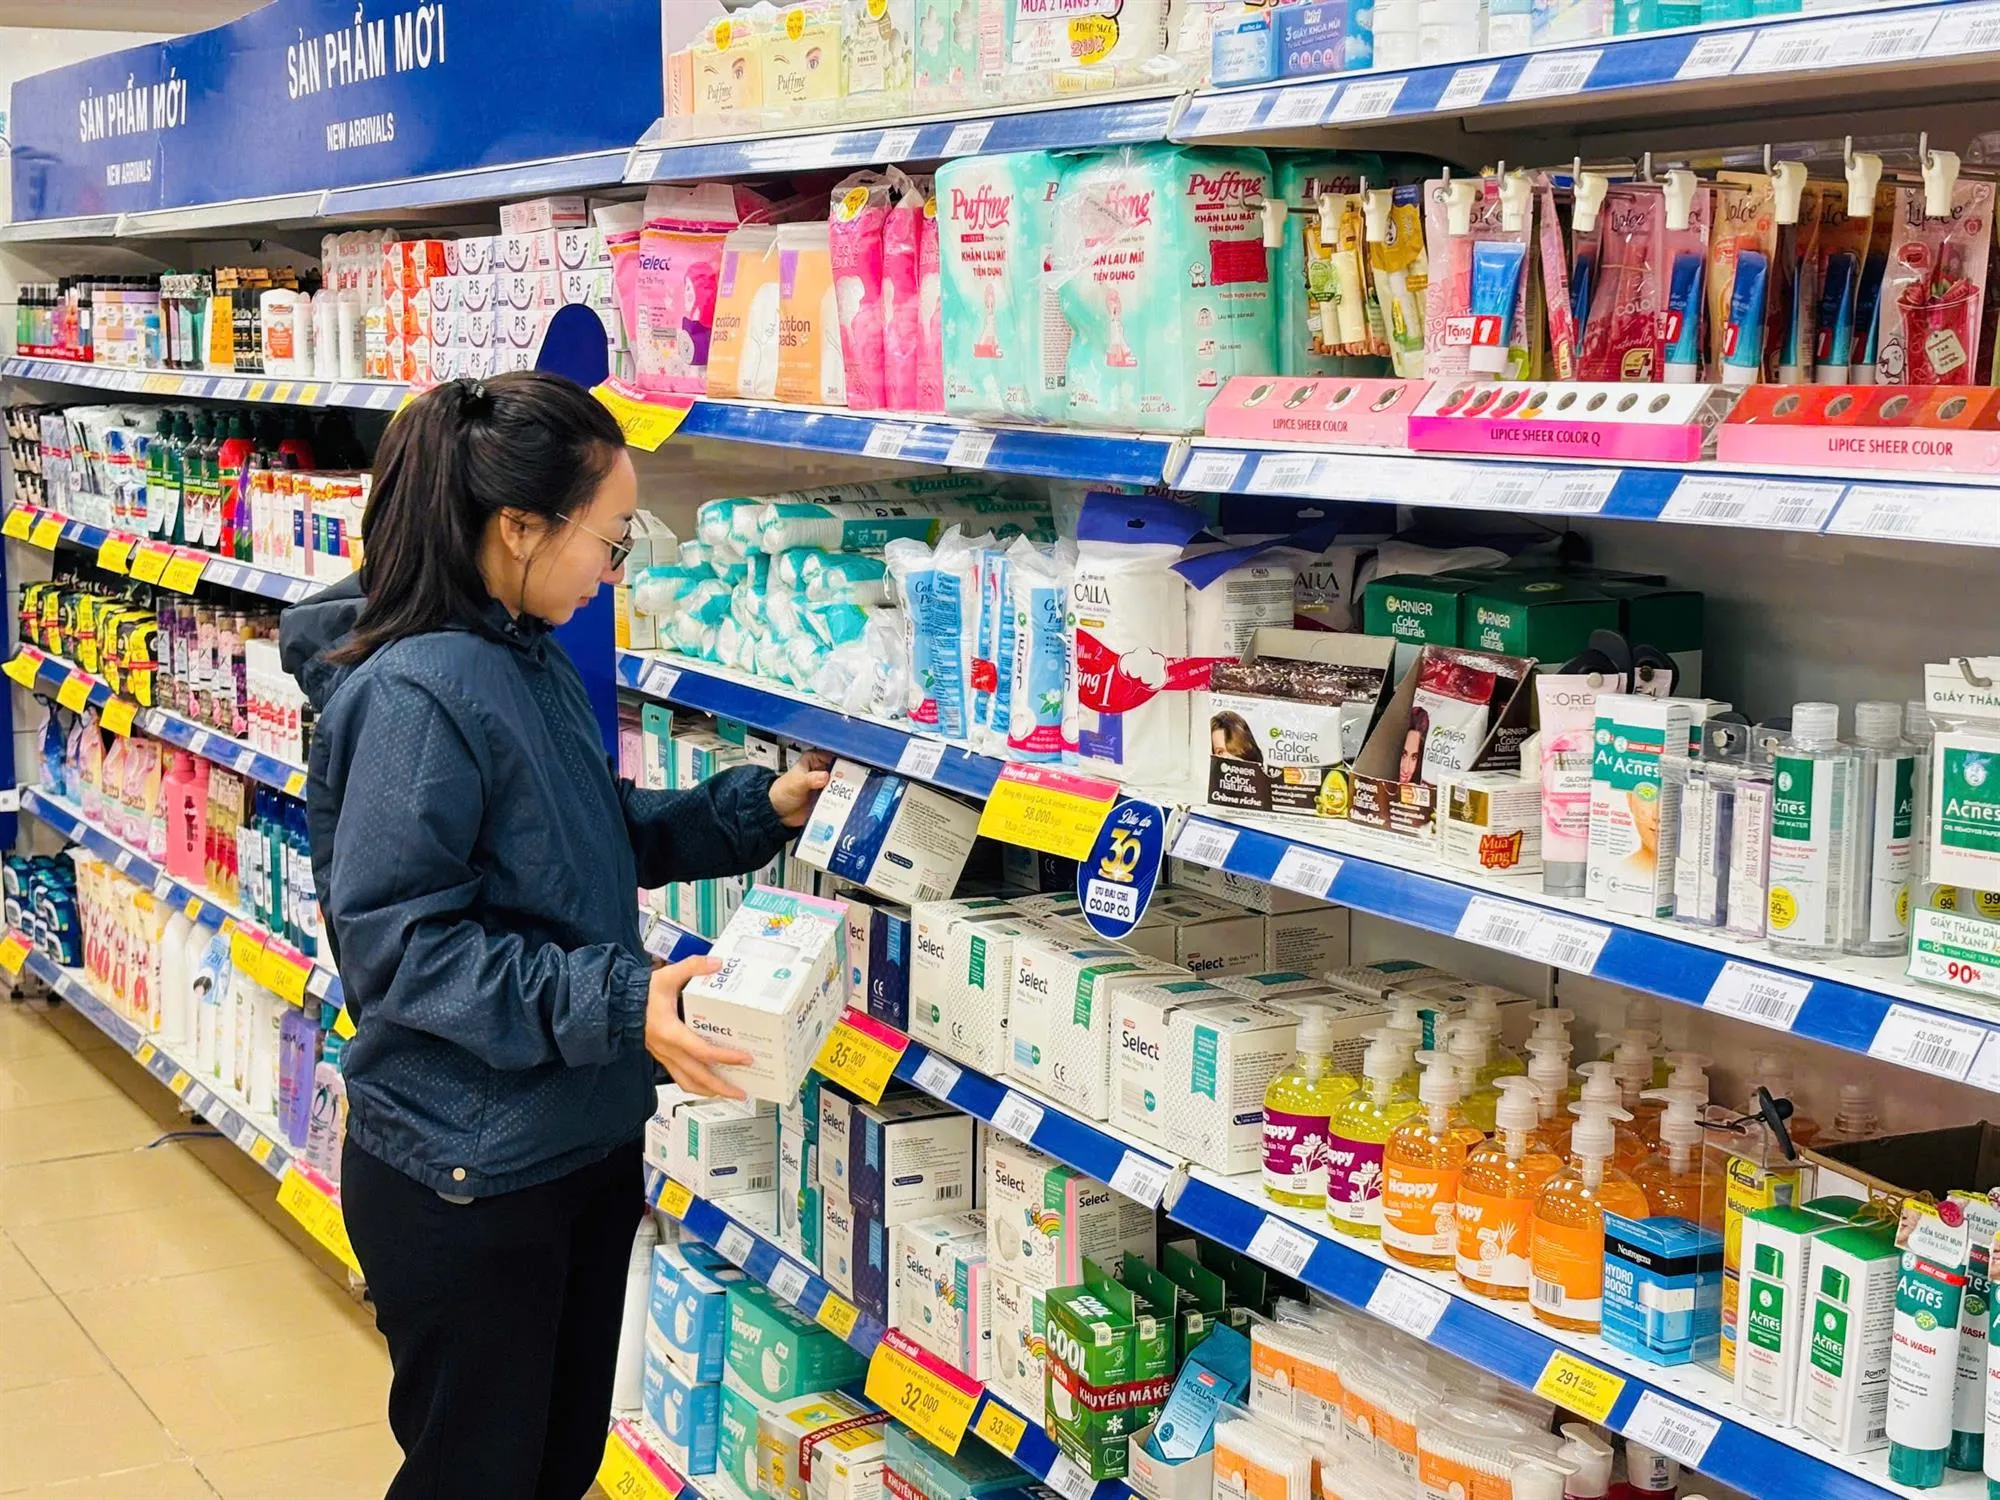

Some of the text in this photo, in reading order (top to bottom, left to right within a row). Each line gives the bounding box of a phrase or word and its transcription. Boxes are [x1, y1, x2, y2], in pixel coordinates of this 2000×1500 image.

[287, 2, 386, 100] SẢN PHẨM
[79, 66, 187, 143] SẢN PHẨM MỚI
[326, 112, 394, 151] NEW ARRIVALS
[106, 160, 152, 186] NEW ARRIVALS
[1186, 171, 1264, 201] Puffme
[951, 185, 1011, 230] Puffme
[1221, 214, 1238, 222] LAU
[509, 239, 520, 256] PS
[565, 235, 578, 251] PS
[513, 278, 525, 294] PS
[569, 276, 581, 293] PS
[514, 315, 527, 332] PS
[1447, 320, 1493, 343] Tặng 1
[1273, 419, 1348, 432] LIPICE SHEER COLOR
[1490, 429, 1600, 445] LIPICE SHEER COLOR Q
[1828, 438, 1953, 456] LIPICE SHEER COLOR
[1074, 583, 1110, 606] CALLA
[1386, 595, 1433, 616] GARNIER
[1397, 615, 1419, 628] Color
[1477, 607, 1510, 628] GARNIER
[1392, 623, 1425, 638] naturals
[1484, 627, 1501, 641] Color
[1100, 665, 1115, 707] 1
[1270, 728, 1318, 741] GARNIER
[1269, 748, 1320, 764] naturals
[1275, 741, 1310, 753] Color
[1425, 748, 1461, 770] naturals
[1613, 757, 1661, 778] Acnes
[1220, 763, 1255, 776] GARNIER
[1224, 773, 1250, 785] Color
[828, 780, 854, 799] Select
[1220, 779, 1256, 794] naturals
[1481, 836, 1507, 849] Mua
[1510, 832, 1522, 862] 1
[1481, 850, 1511, 868] Tặng
[1930, 916, 1951, 932] GIẤY
[1954, 920, 1981, 935] THẤM
[917, 934, 945, 959] Select
[1961, 936, 1988, 949] XANH
[710, 957, 740, 989] Select
[1188, 957, 1224, 972] Select
[873, 979, 884, 997] CE
[1019, 968, 1048, 994] Select
[692, 1019, 732, 1036] Select
[1914, 1030, 1944, 1045] 43.000
[1122, 1030, 1160, 1060] Select
[823, 1108, 846, 1135] Select
[782, 1150, 798, 1171] Select
[995, 1170, 1025, 1193] Select
[1388, 1180, 1438, 1198] Happy
[1079, 1192, 1110, 1208] Select
[1728, 1197, 1751, 1216] Melano
[826, 1207, 849, 1233] Select
[1617, 1243, 1652, 1266] Neutrogena
[907, 1255, 932, 1282] Select
[1605, 1261, 1633, 1284] HYDRO
[1604, 1276, 1633, 1296] BOOST
[1897, 1275, 1943, 1310] Acnes
[996, 1287, 1019, 1314] Select
[1750, 1310, 1781, 1331] Acnes
[1047, 1320, 1089, 1381] COOL
[1813, 1331, 1843, 1355] Acnes
[1910, 1340, 1936, 1356] WASH
[901, 1382, 939, 1413] 32.000
[1079, 1385, 1126, 1408] KHUYẾN
[1661, 1416, 1689, 1435] 361.400
